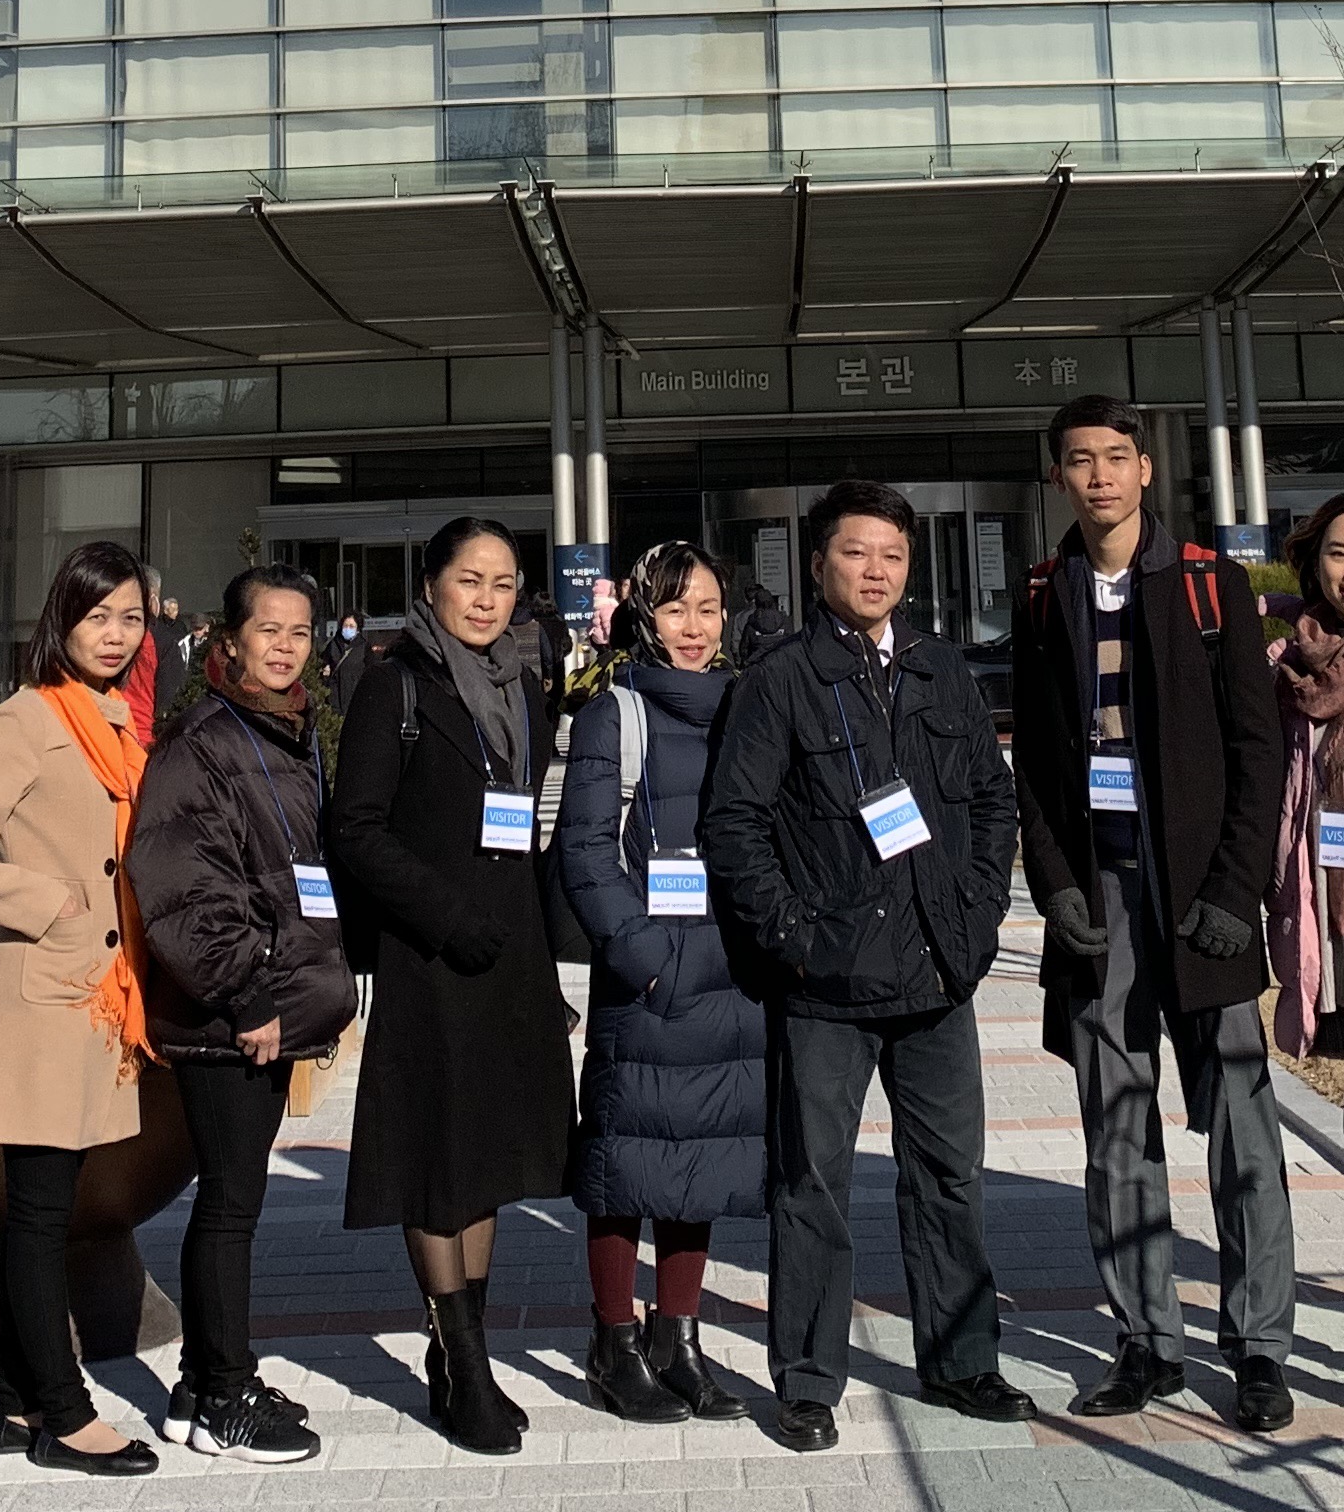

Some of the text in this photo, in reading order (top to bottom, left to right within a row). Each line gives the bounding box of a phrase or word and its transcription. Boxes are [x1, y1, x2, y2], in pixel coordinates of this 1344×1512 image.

[640, 369, 771, 392] Main Building
[836, 356, 915, 396] 본관
[1013, 356, 1079, 387] 本館
[488, 810, 527, 825] VISITOR
[873, 806, 914, 833] VISITOR
[300, 881, 328, 894] VISITOR
[654, 877, 700, 889] VISITOR
